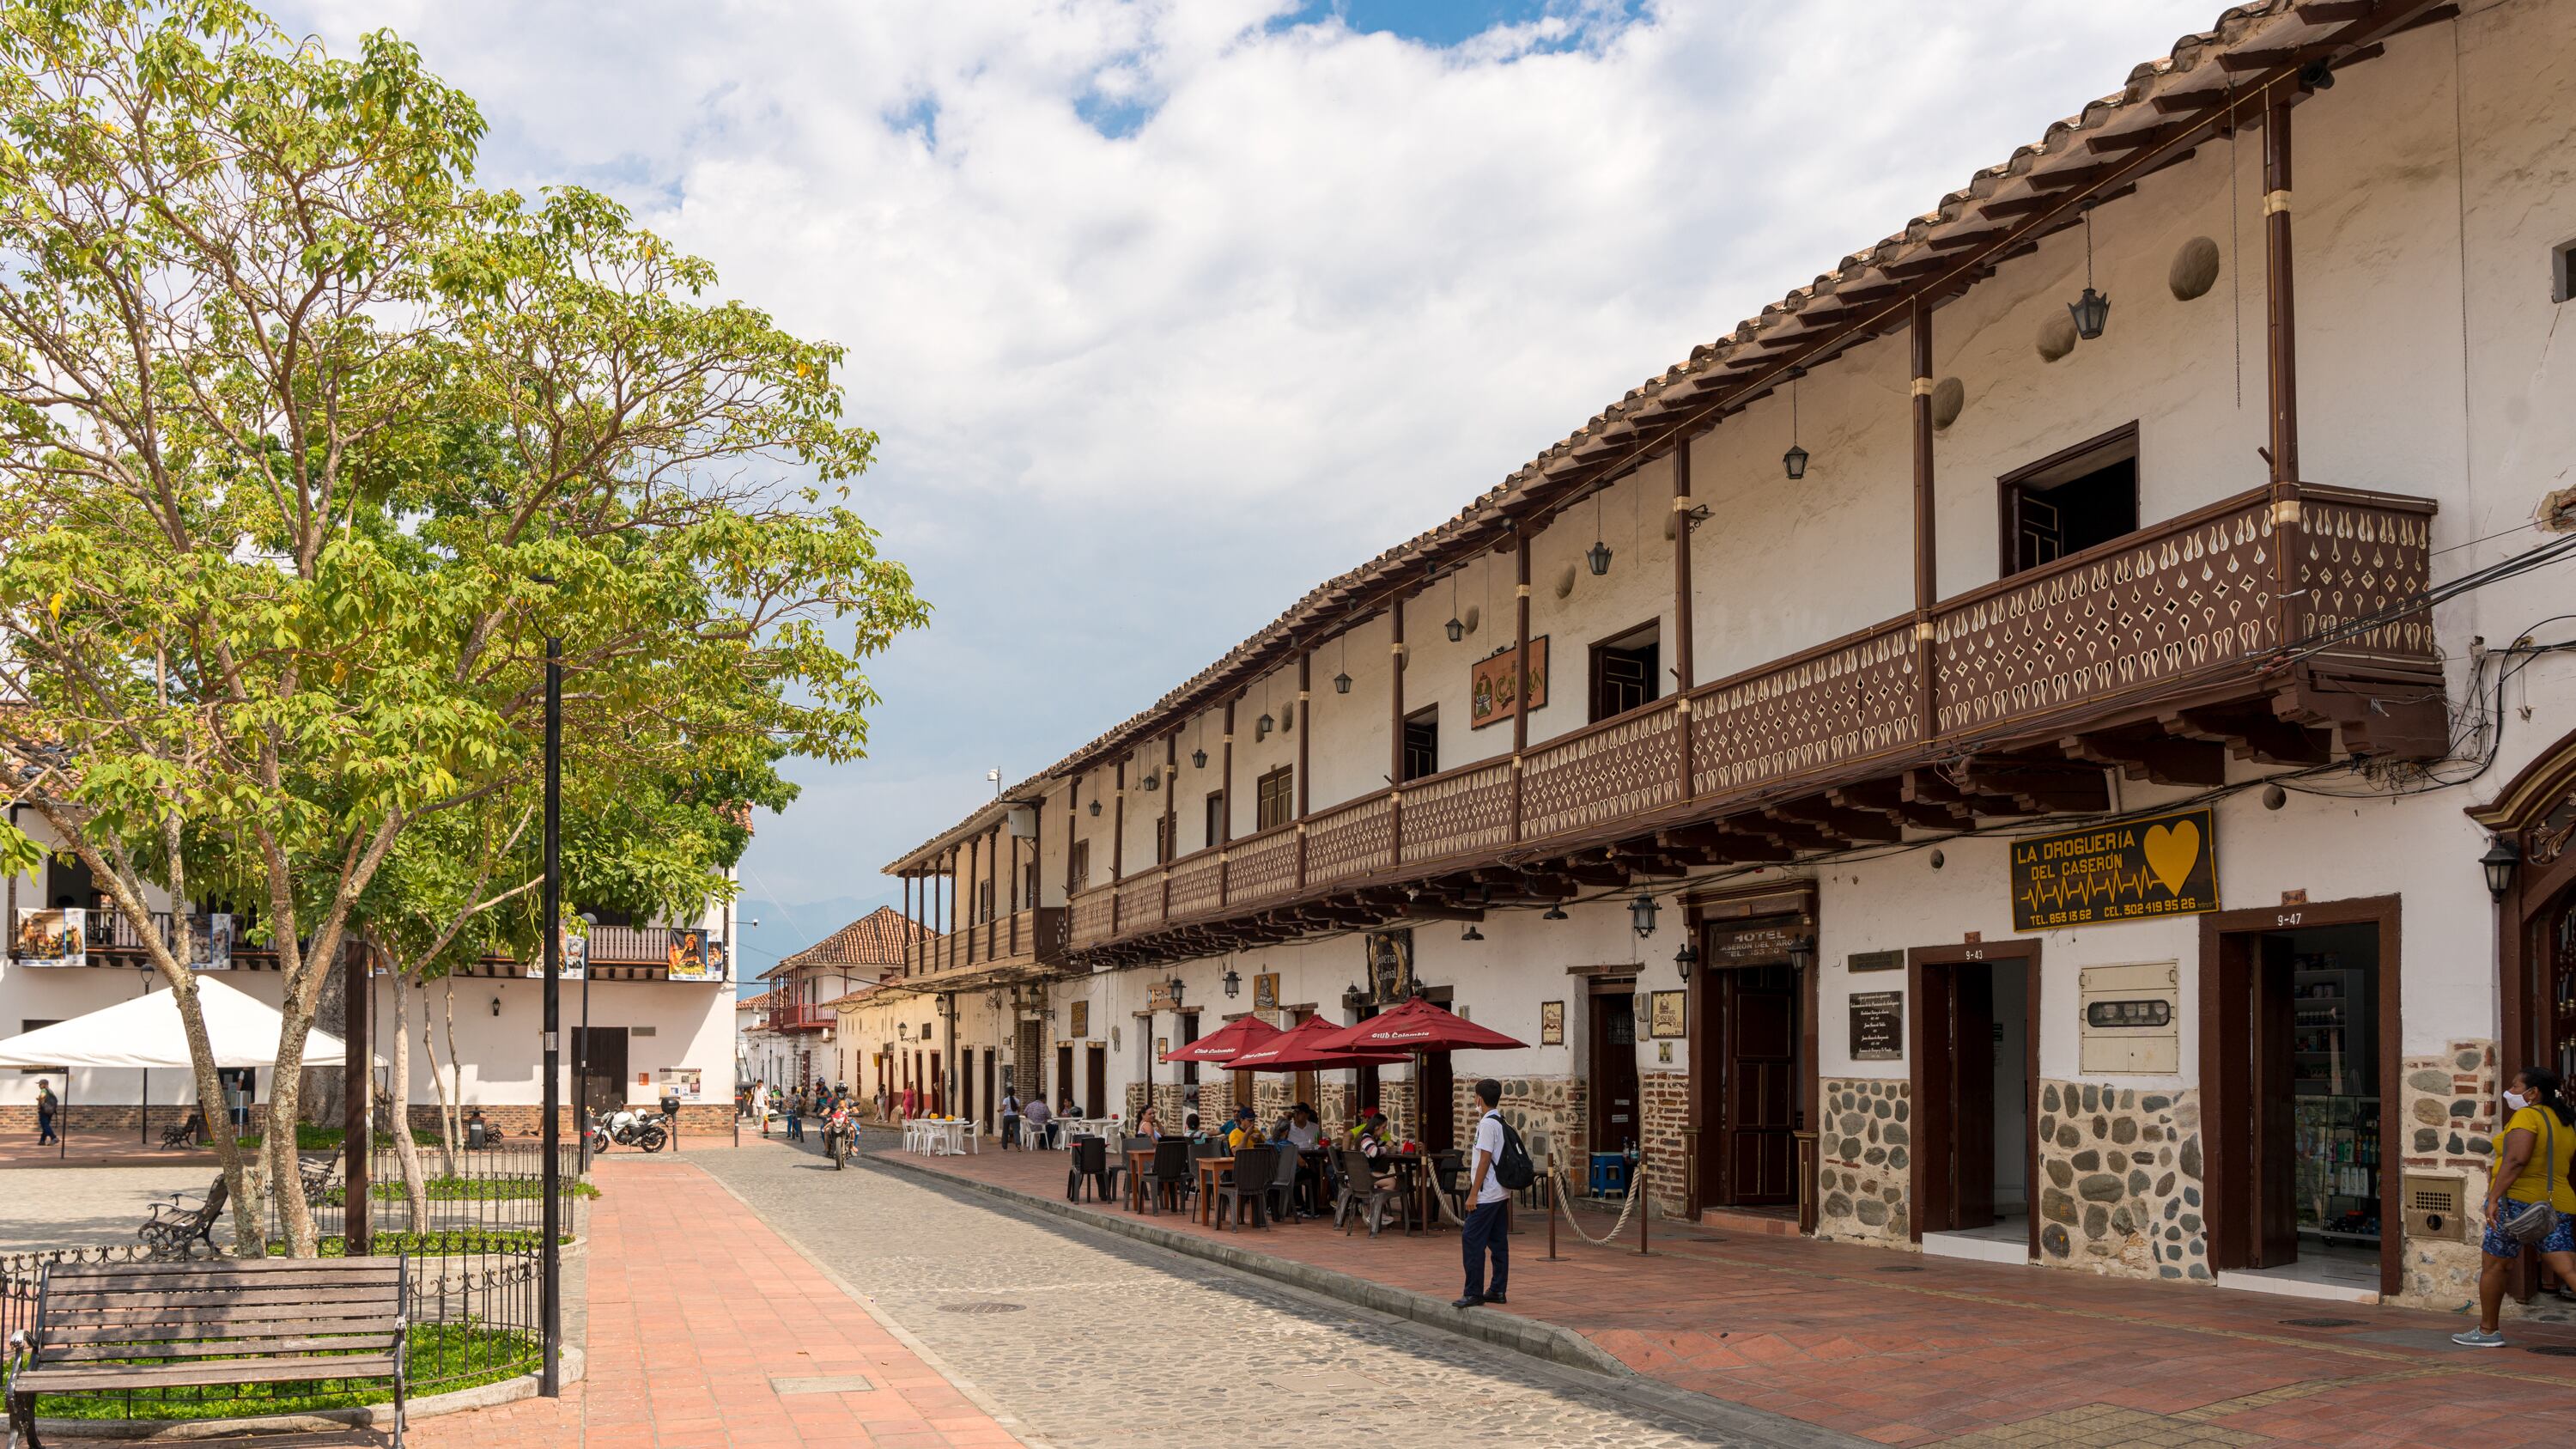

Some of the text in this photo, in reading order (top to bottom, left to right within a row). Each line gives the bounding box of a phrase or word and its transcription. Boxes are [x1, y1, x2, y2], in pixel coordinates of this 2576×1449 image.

[2017, 831, 2135, 864] LA DROGUERÍA
[2031, 852, 2123, 880] DEL CASERÓN
[2030, 914, 2048, 926] TEL.
[2050, 911, 2067, 924] 853
[2069, 910, 2077, 922] 13
[2079, 909, 2092, 920] 62
[2104, 906, 2123, 917] CEL.
[2123, 903, 2144, 916] 302
[2145, 900, 2163, 913] 419
[2164, 898, 2179, 911] 95
[2181, 898, 2196, 910] 26
[2277, 912, 2301, 926] 9-47
[1735, 930, 1786, 942] HOTEL
[1965, 949, 1983, 960] 9-43
